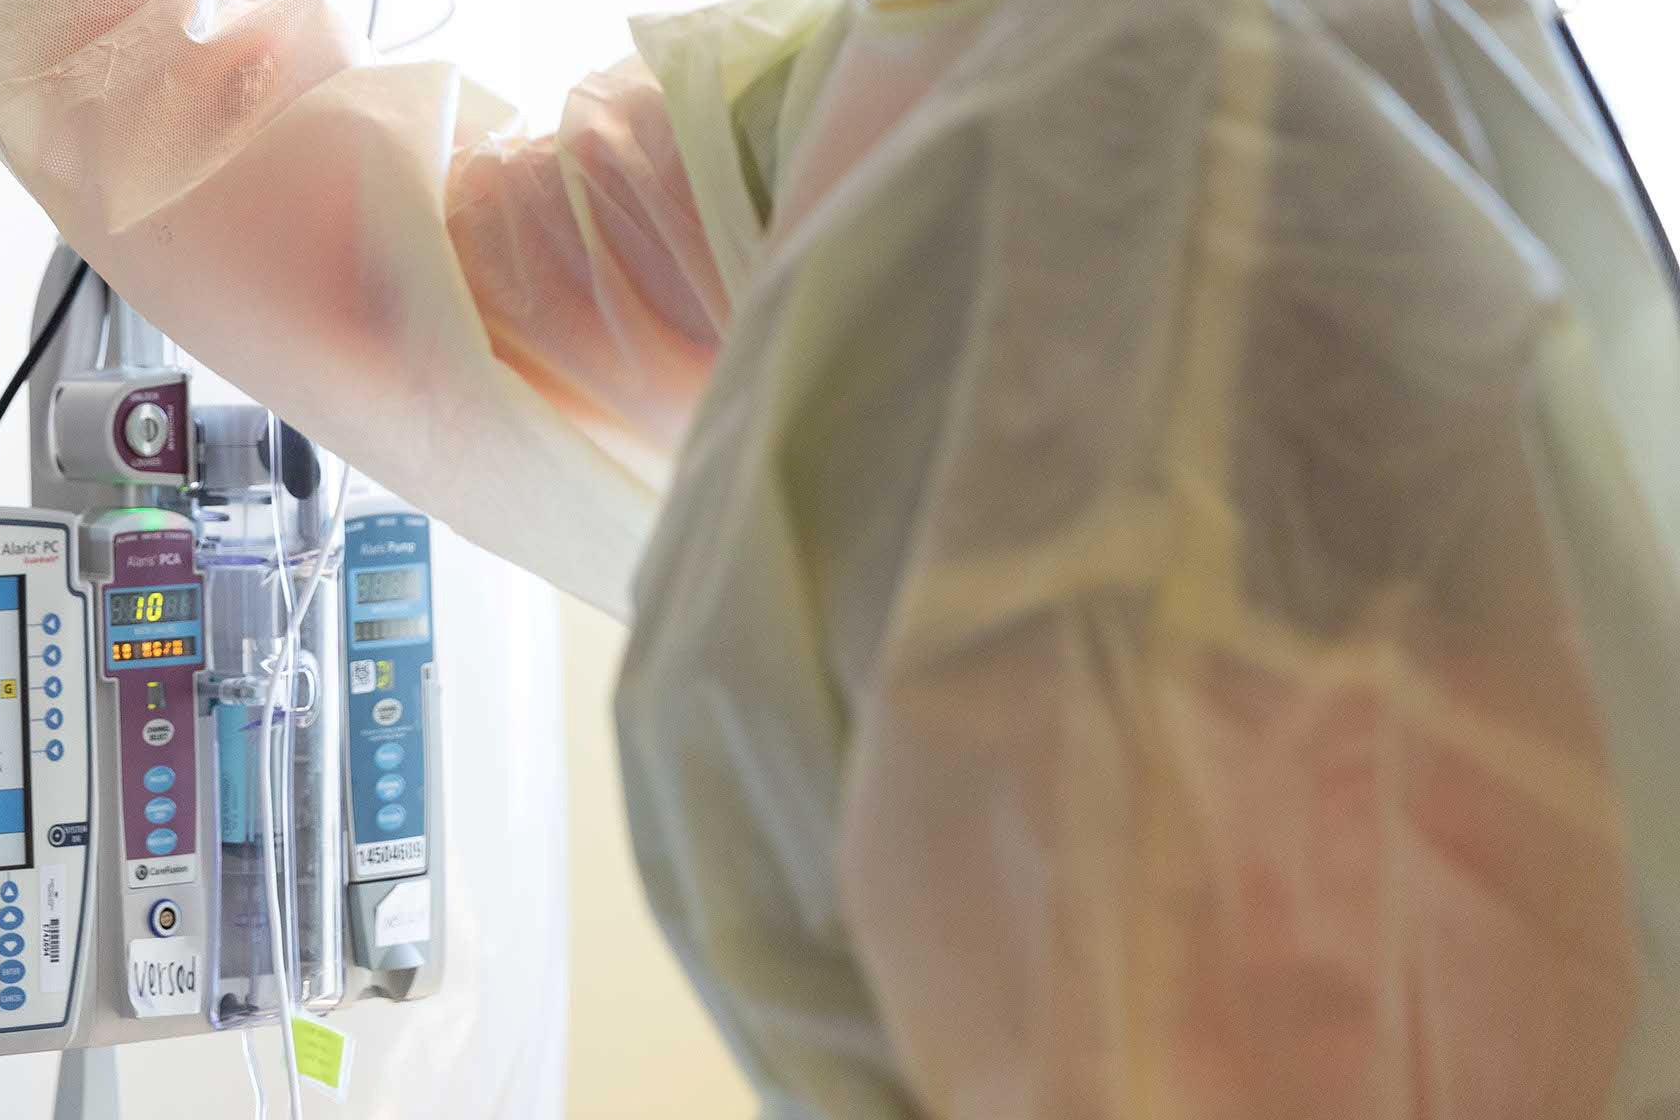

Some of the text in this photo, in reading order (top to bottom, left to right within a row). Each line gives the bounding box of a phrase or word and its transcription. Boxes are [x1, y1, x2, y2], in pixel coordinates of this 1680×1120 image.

[43, 540, 59, 554] PC
[136, 592, 164, 621] 10
[4, 683, 12, 694] G
